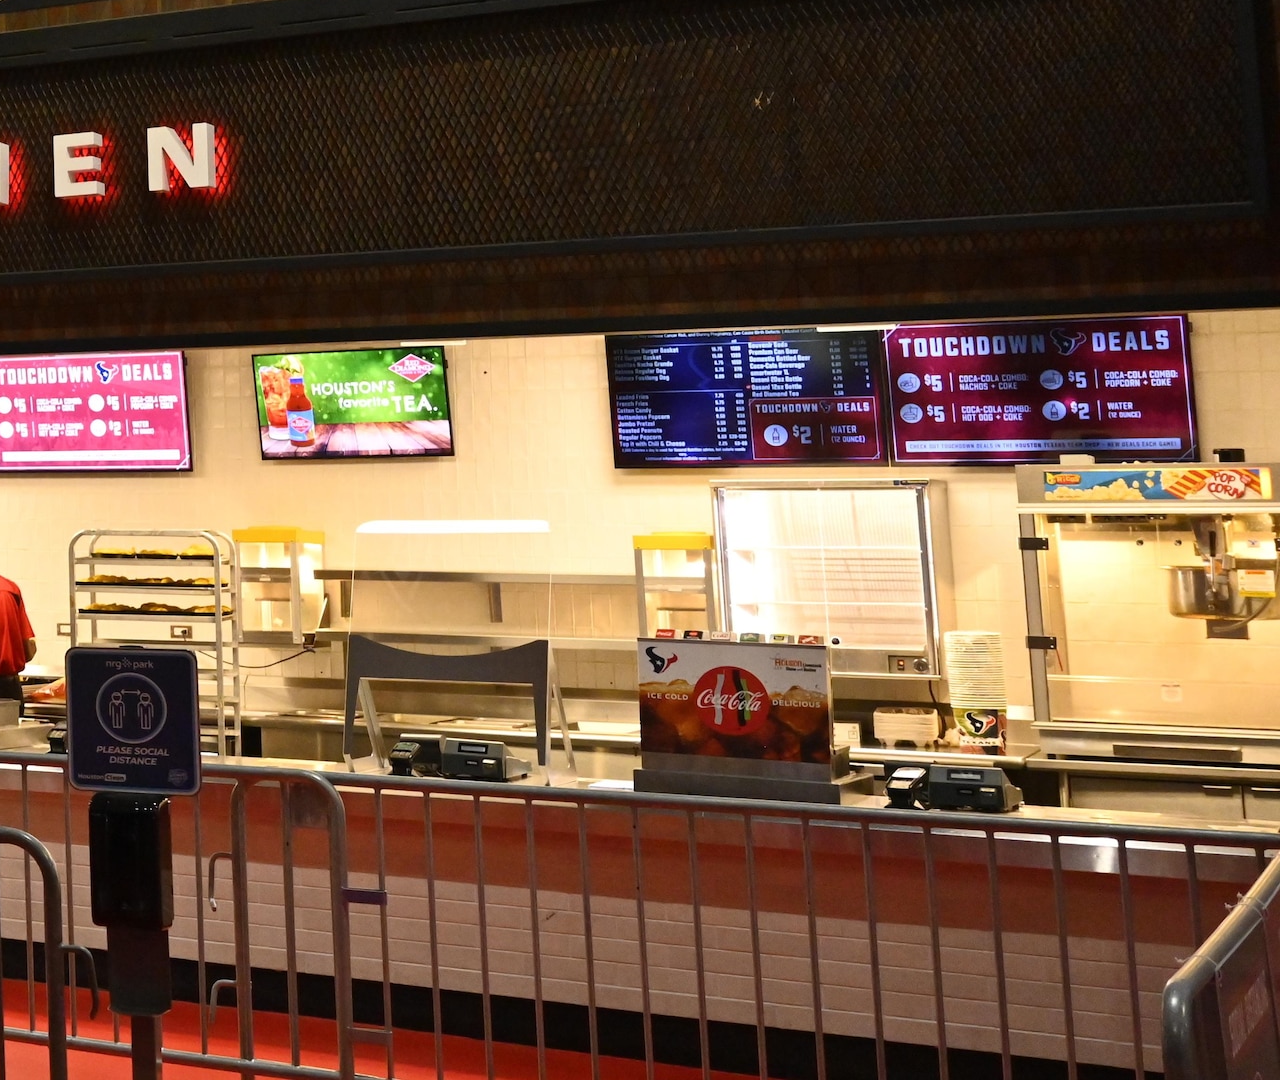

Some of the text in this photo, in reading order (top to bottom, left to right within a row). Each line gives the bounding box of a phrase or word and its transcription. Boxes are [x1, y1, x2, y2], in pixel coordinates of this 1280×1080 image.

[898, 329, 1171, 358] TOUCHDOWN DEALS
[122, 363, 172, 382] DEALS
[959, 373, 1029, 383] COCA-COLA COMBO:
[1104, 370, 1178, 380] COCA-COLA COMBO:
[924, 373, 942, 392] $5
[1068, 370, 1087, 388] $5
[1105, 378, 1171, 387] POPCORN COKE
[311, 381, 395, 396] HOUSTON'S
[959, 382, 1018, 391] NACHOS COKE
[338, 395, 438, 413] favorite TEA.
[755, 402, 870, 413] TOUCHDOWN DEALS
[961, 405, 1031, 414] COCA-COLA COMBO:
[1107, 402, 1133, 410] WATER
[927, 404, 945, 423] $5
[1070, 401, 1090, 419] $2
[962, 413, 1023, 422] HOT DOG COKE
[792, 424, 812, 444] $2
[830, 425, 857, 434] WATER
[842, 435, 866, 443] OUNCE)
[1214, 472, 1236, 484] POP
[106, 659, 154, 670] nrg park
[647, 692, 689, 701] ICE COLD
[697, 688, 764, 711] Coca-Cola
[772, 699, 821, 709] DELICIOUS
[96, 746, 169, 757] PLEASE SOCIAL
[109, 756, 157, 766] DISTANCE
